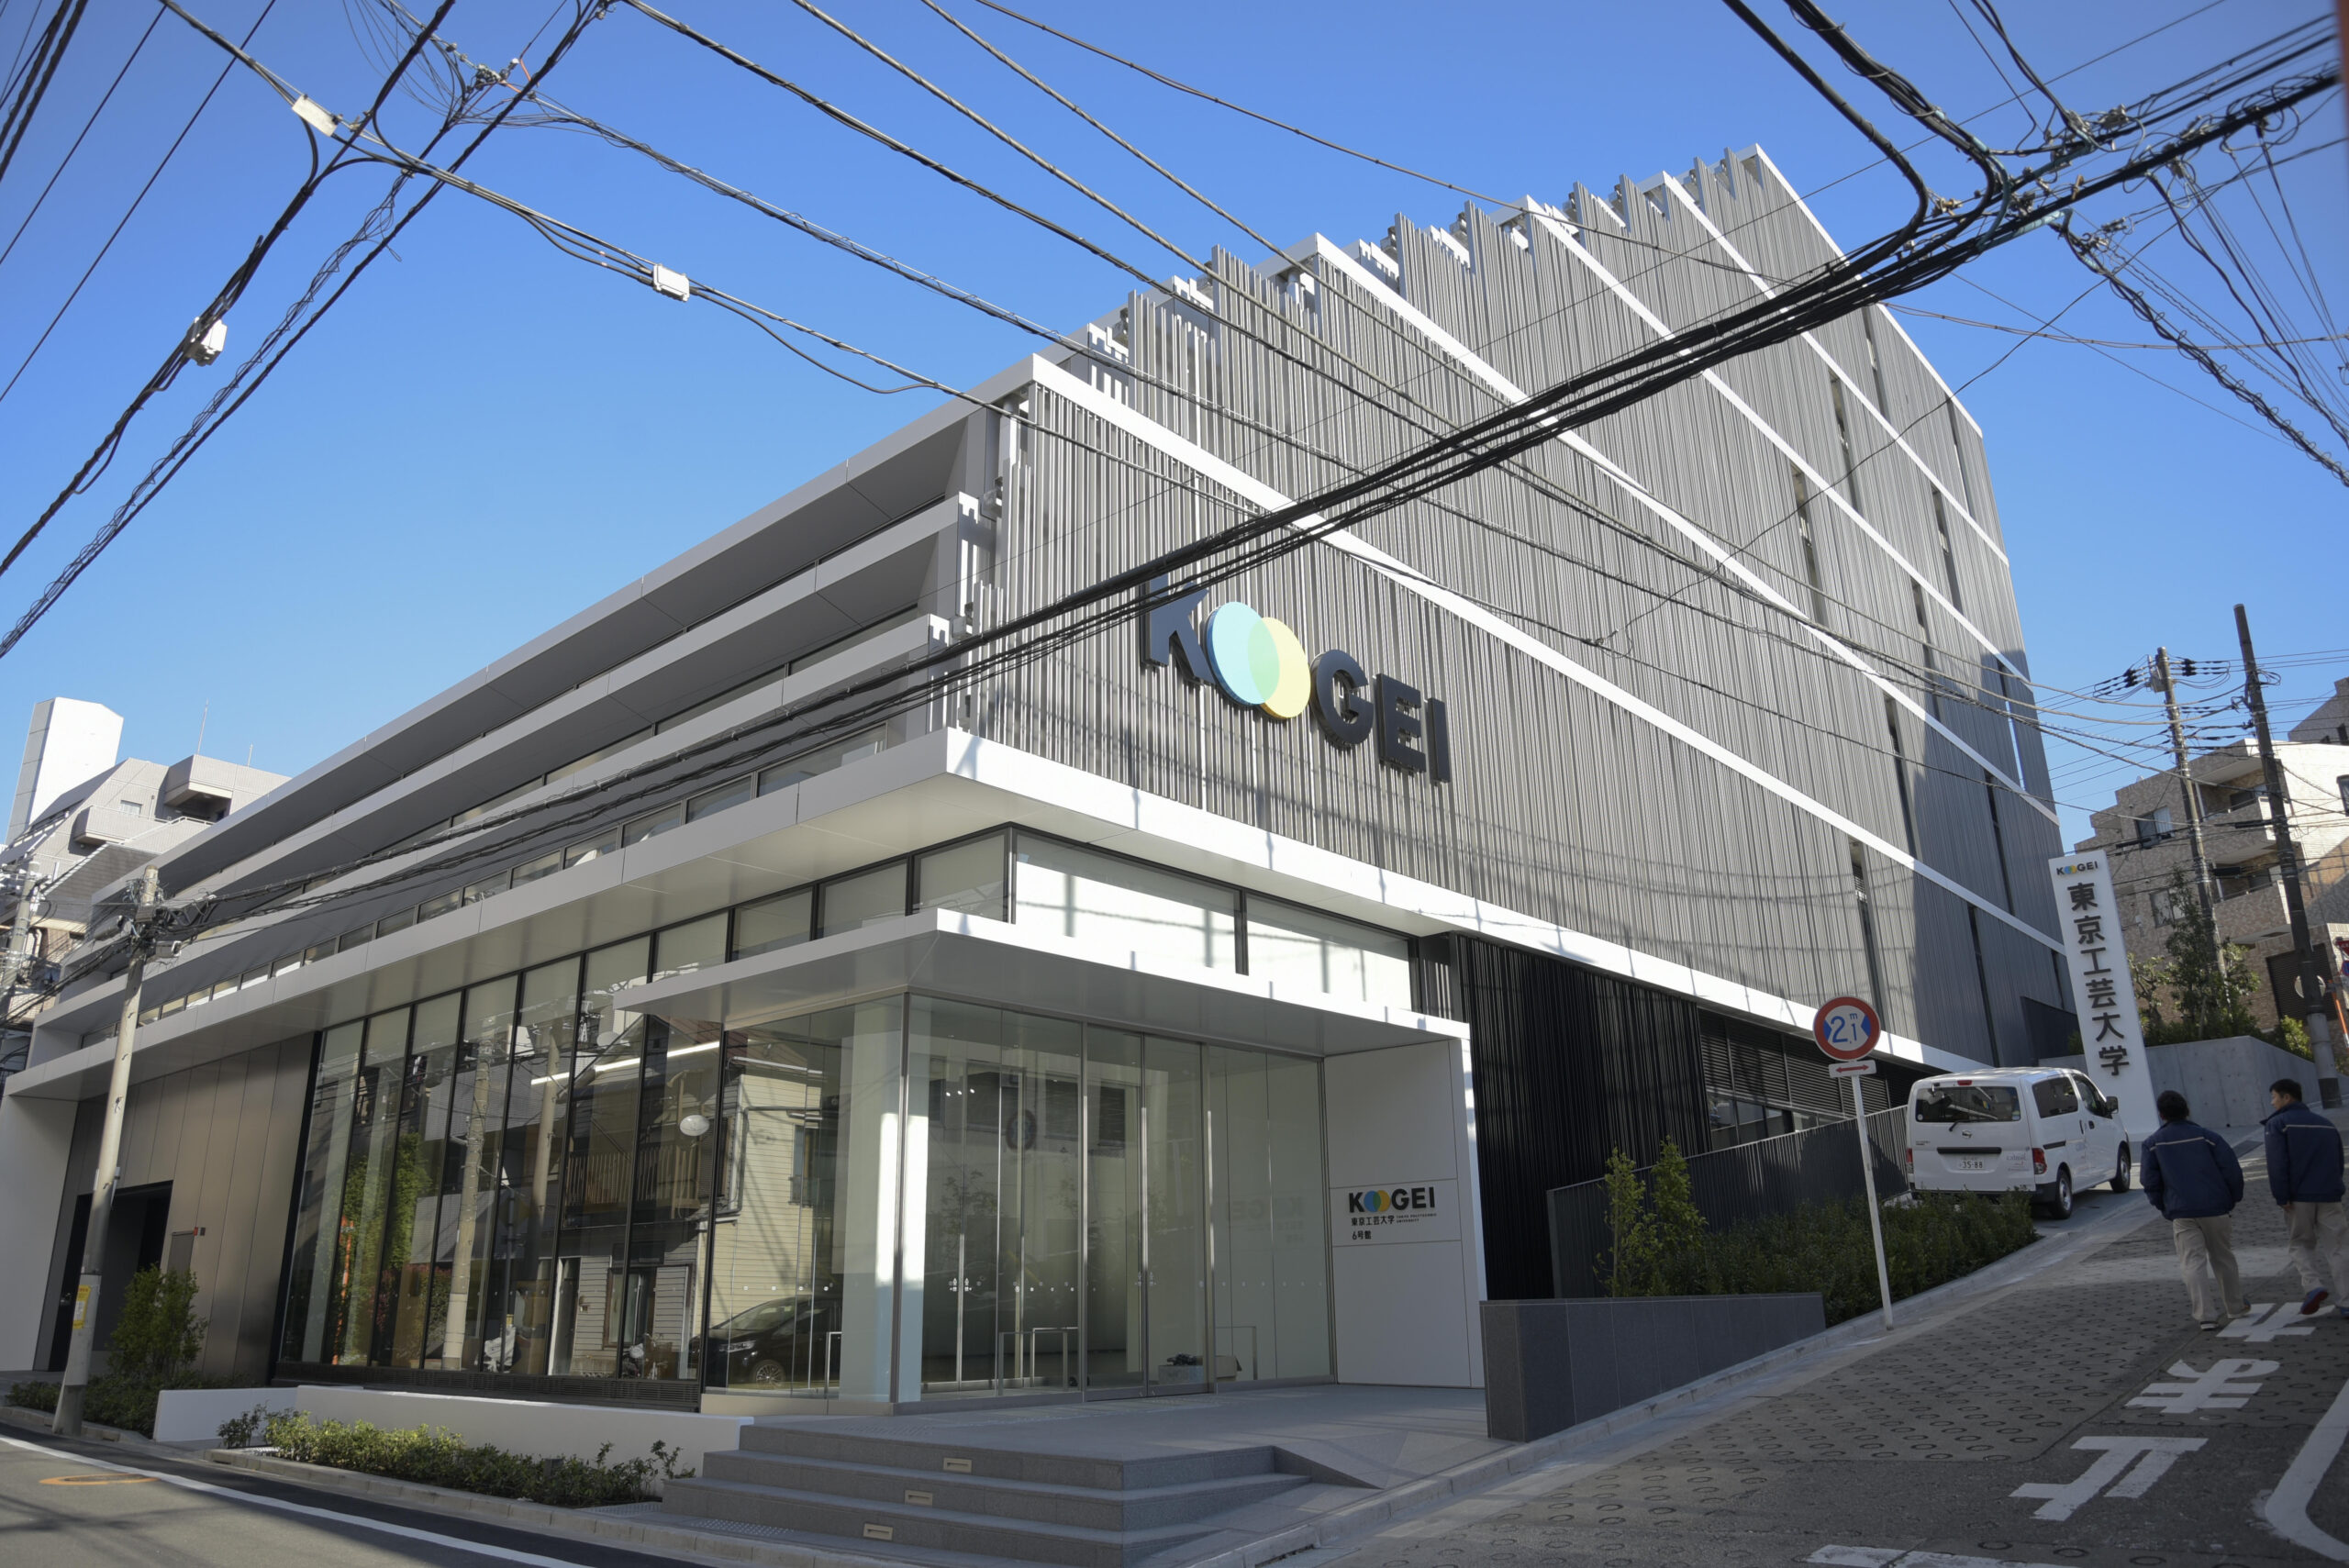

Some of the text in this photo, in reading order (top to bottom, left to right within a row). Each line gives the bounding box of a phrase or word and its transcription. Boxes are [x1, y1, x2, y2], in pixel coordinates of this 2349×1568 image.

[2067, 882, 2130, 1076] 東京工芸大学
[1351, 1215, 1395, 1227] 東京工芸大学
[1352, 1230, 1372, 1240] 6号館
